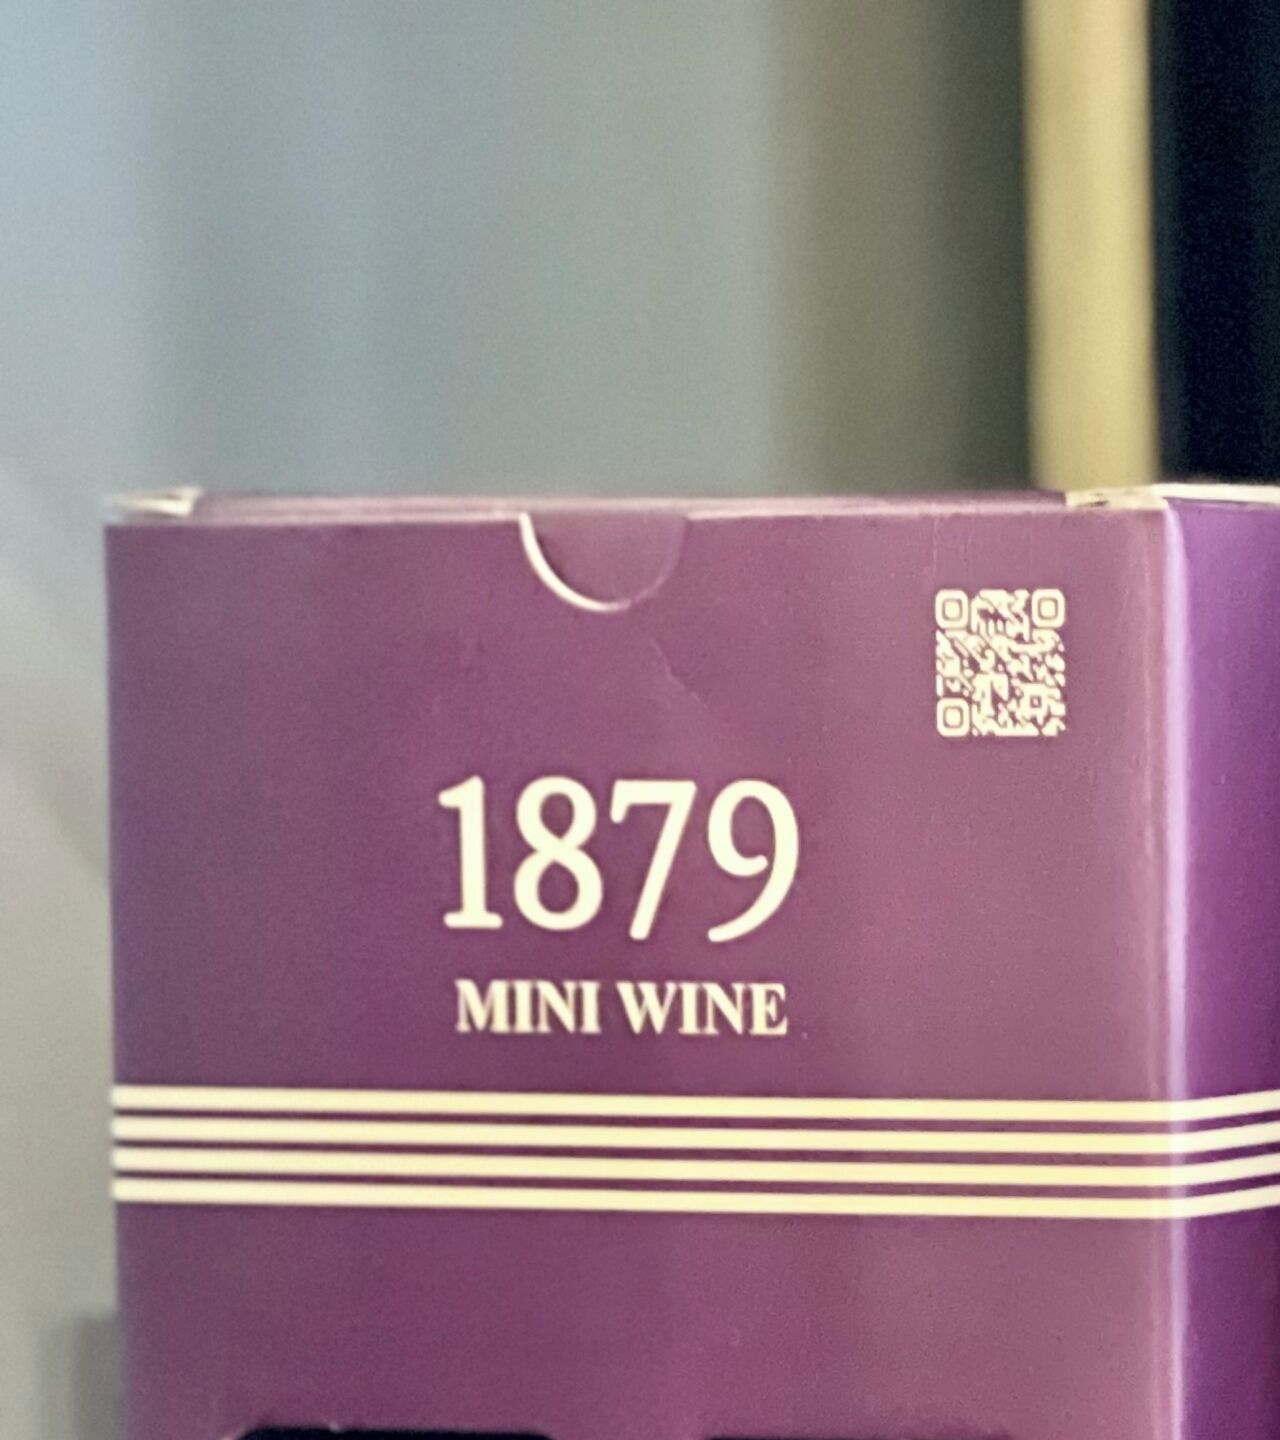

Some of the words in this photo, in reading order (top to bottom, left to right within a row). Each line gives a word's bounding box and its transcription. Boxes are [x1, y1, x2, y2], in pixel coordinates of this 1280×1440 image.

[438, 775, 798, 942] 1879
[455, 980, 602, 1034] MINI
[618, 981, 788, 1037] WINE
